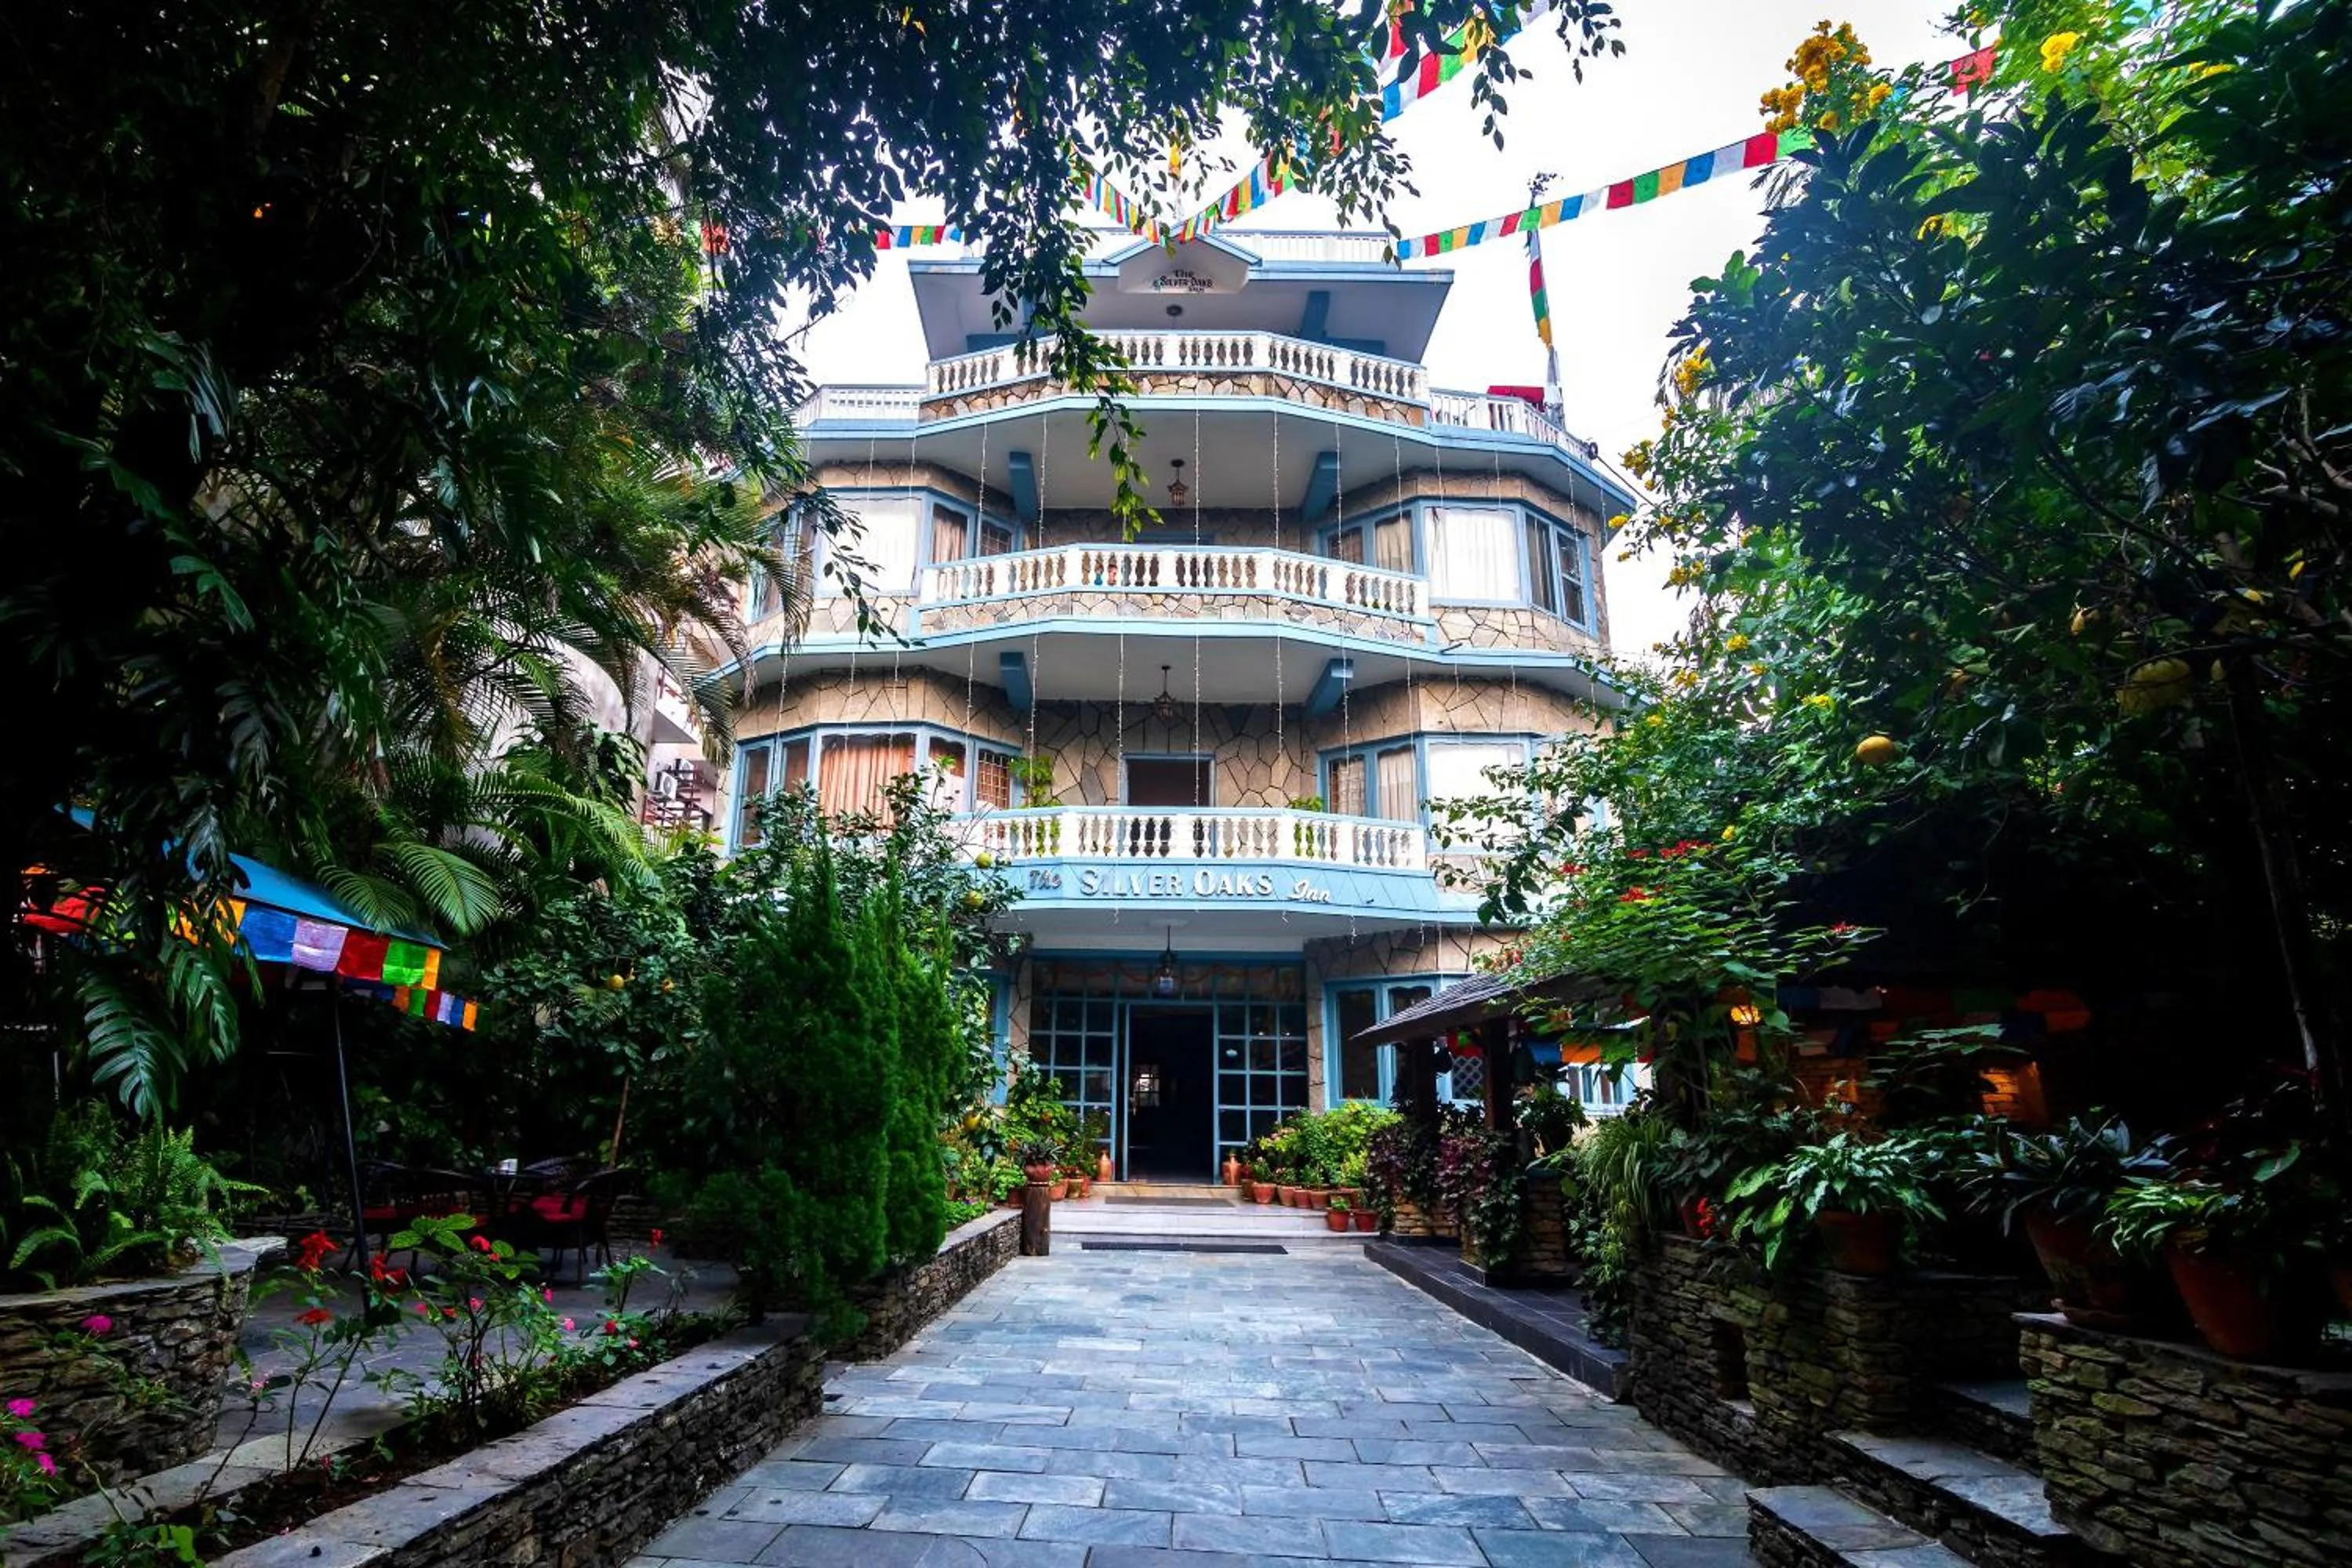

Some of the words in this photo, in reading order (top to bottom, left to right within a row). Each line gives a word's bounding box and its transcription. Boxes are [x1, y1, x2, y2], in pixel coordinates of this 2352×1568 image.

[1029, 869, 1062, 890] The
[1080, 868, 1183, 896] SILVER
[1193, 868, 1274, 896] OAKS
[1286, 878, 1330, 903] Inn
